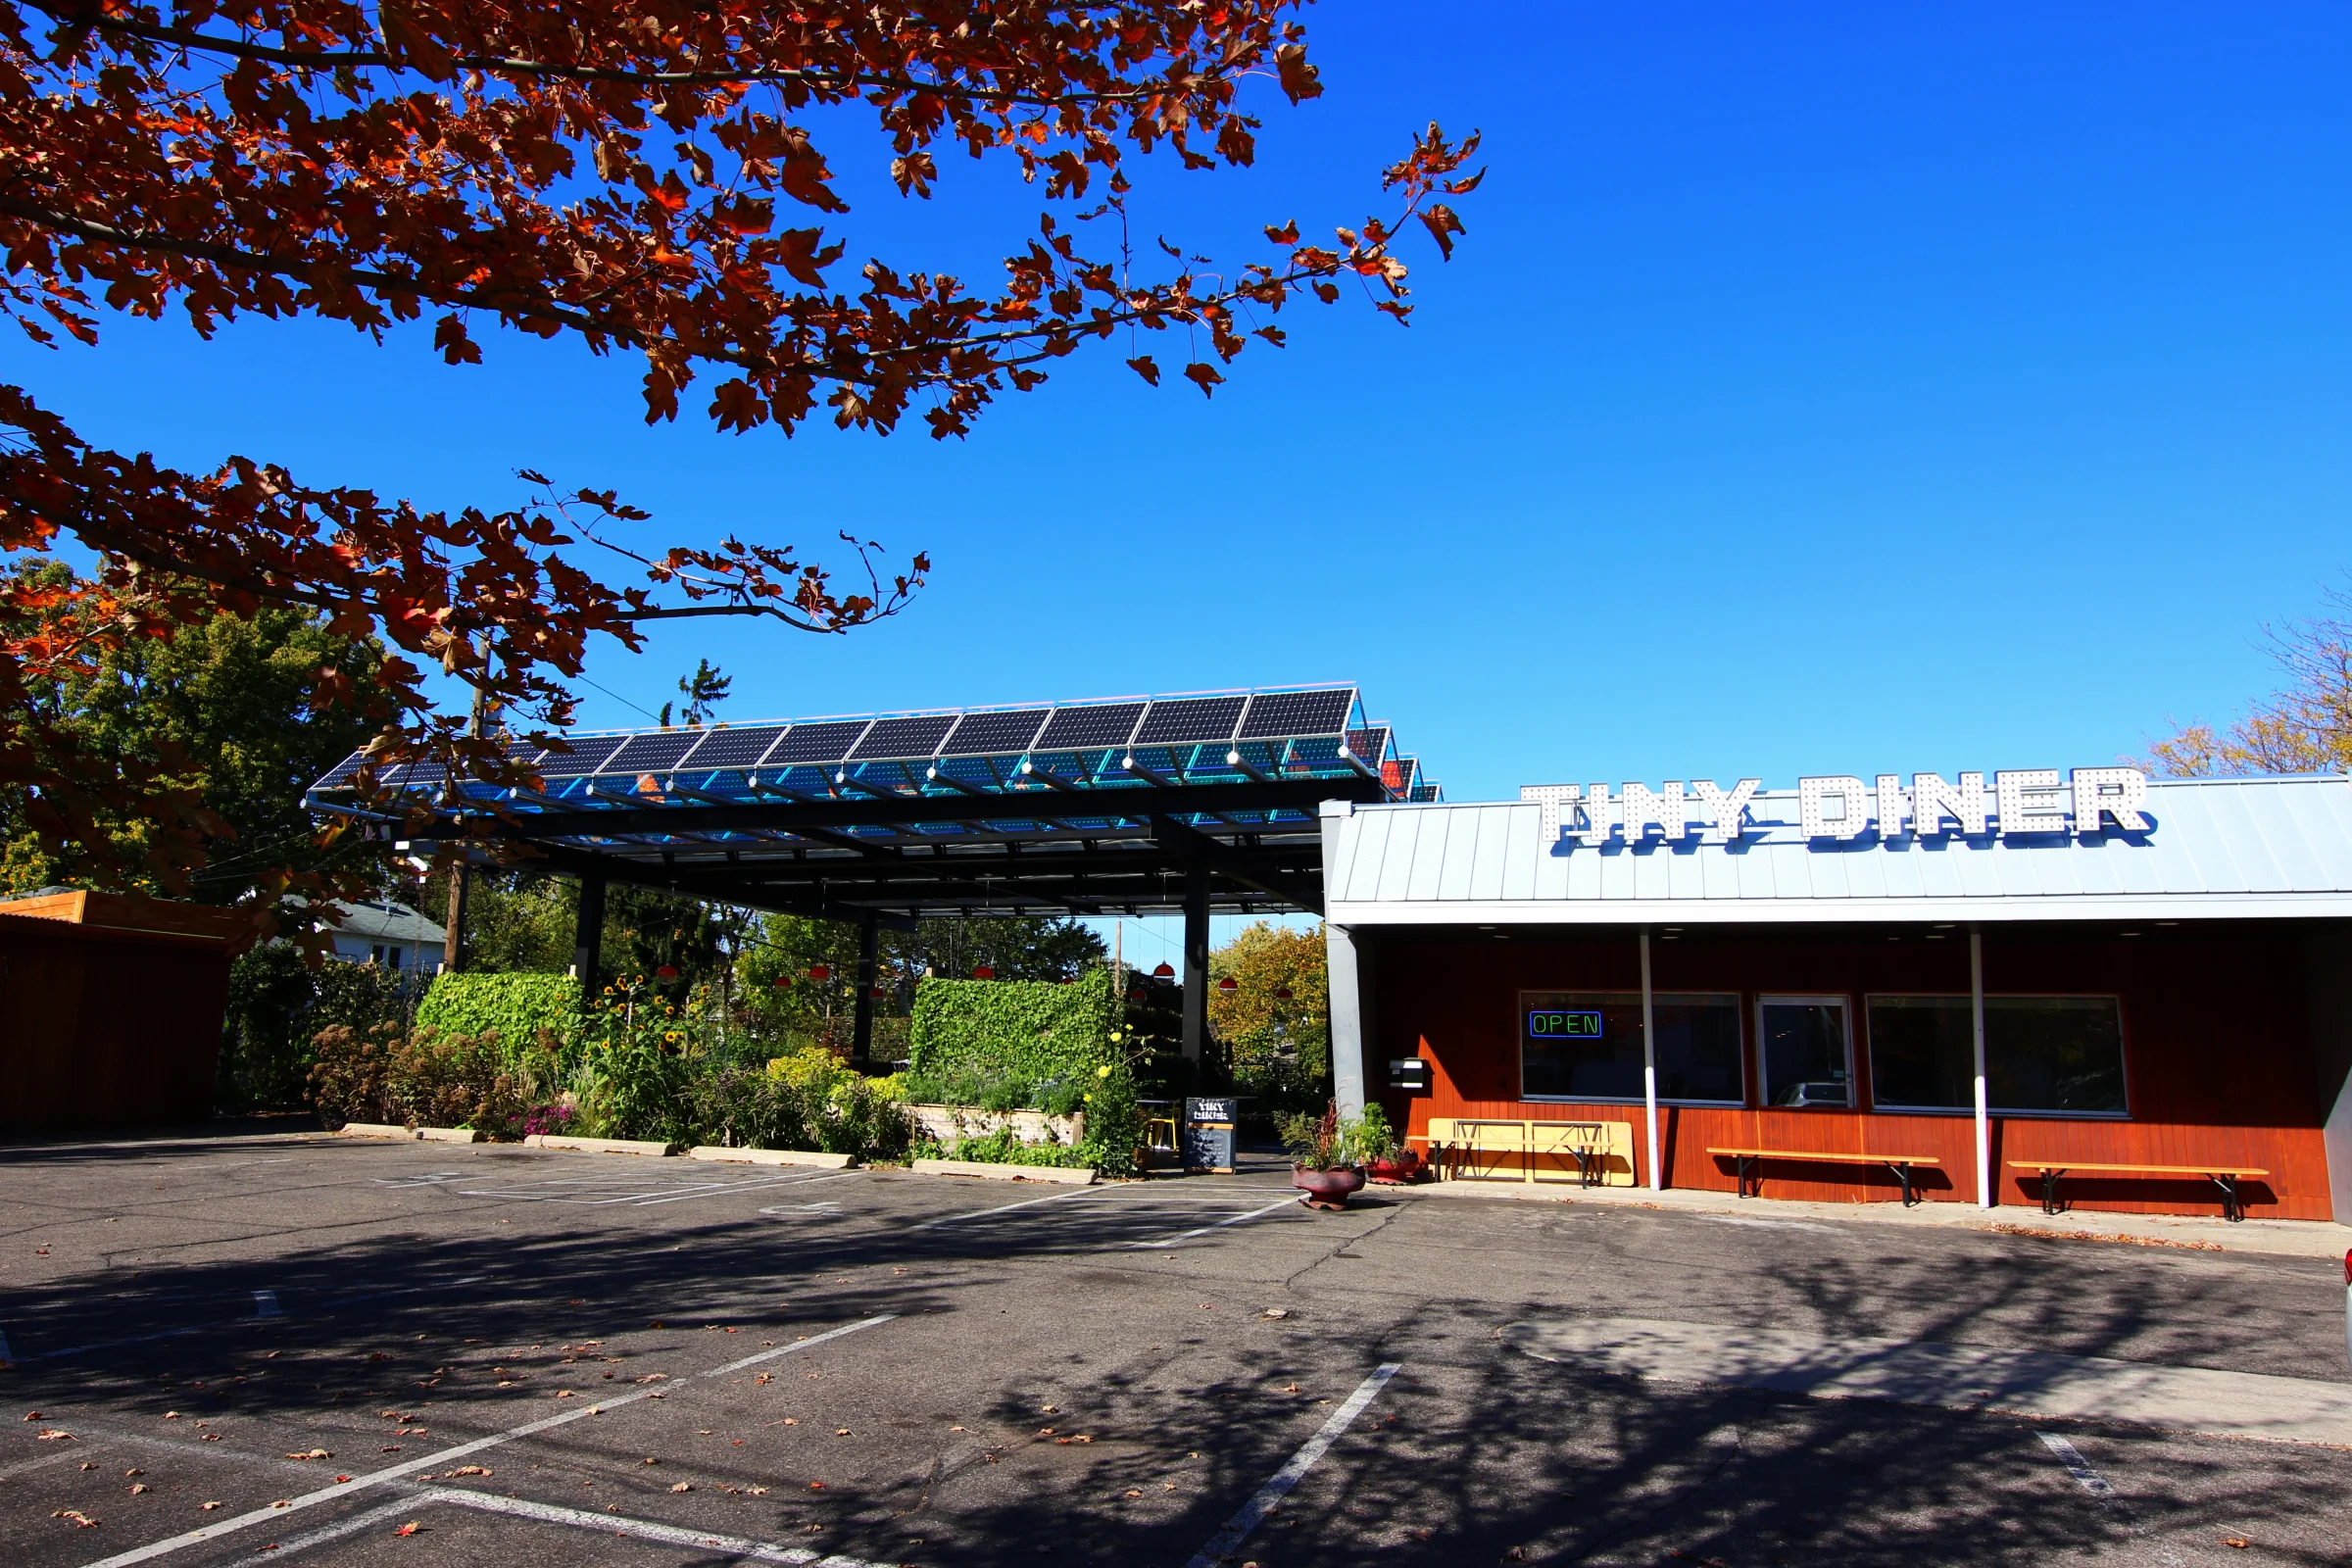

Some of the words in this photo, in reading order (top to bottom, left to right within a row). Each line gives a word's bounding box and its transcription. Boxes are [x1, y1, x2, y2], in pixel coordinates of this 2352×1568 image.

[1520, 778, 1763, 843] TINY
[1798, 766, 2151, 838] DINER
[1534, 1014, 1597, 1034] OPEN
